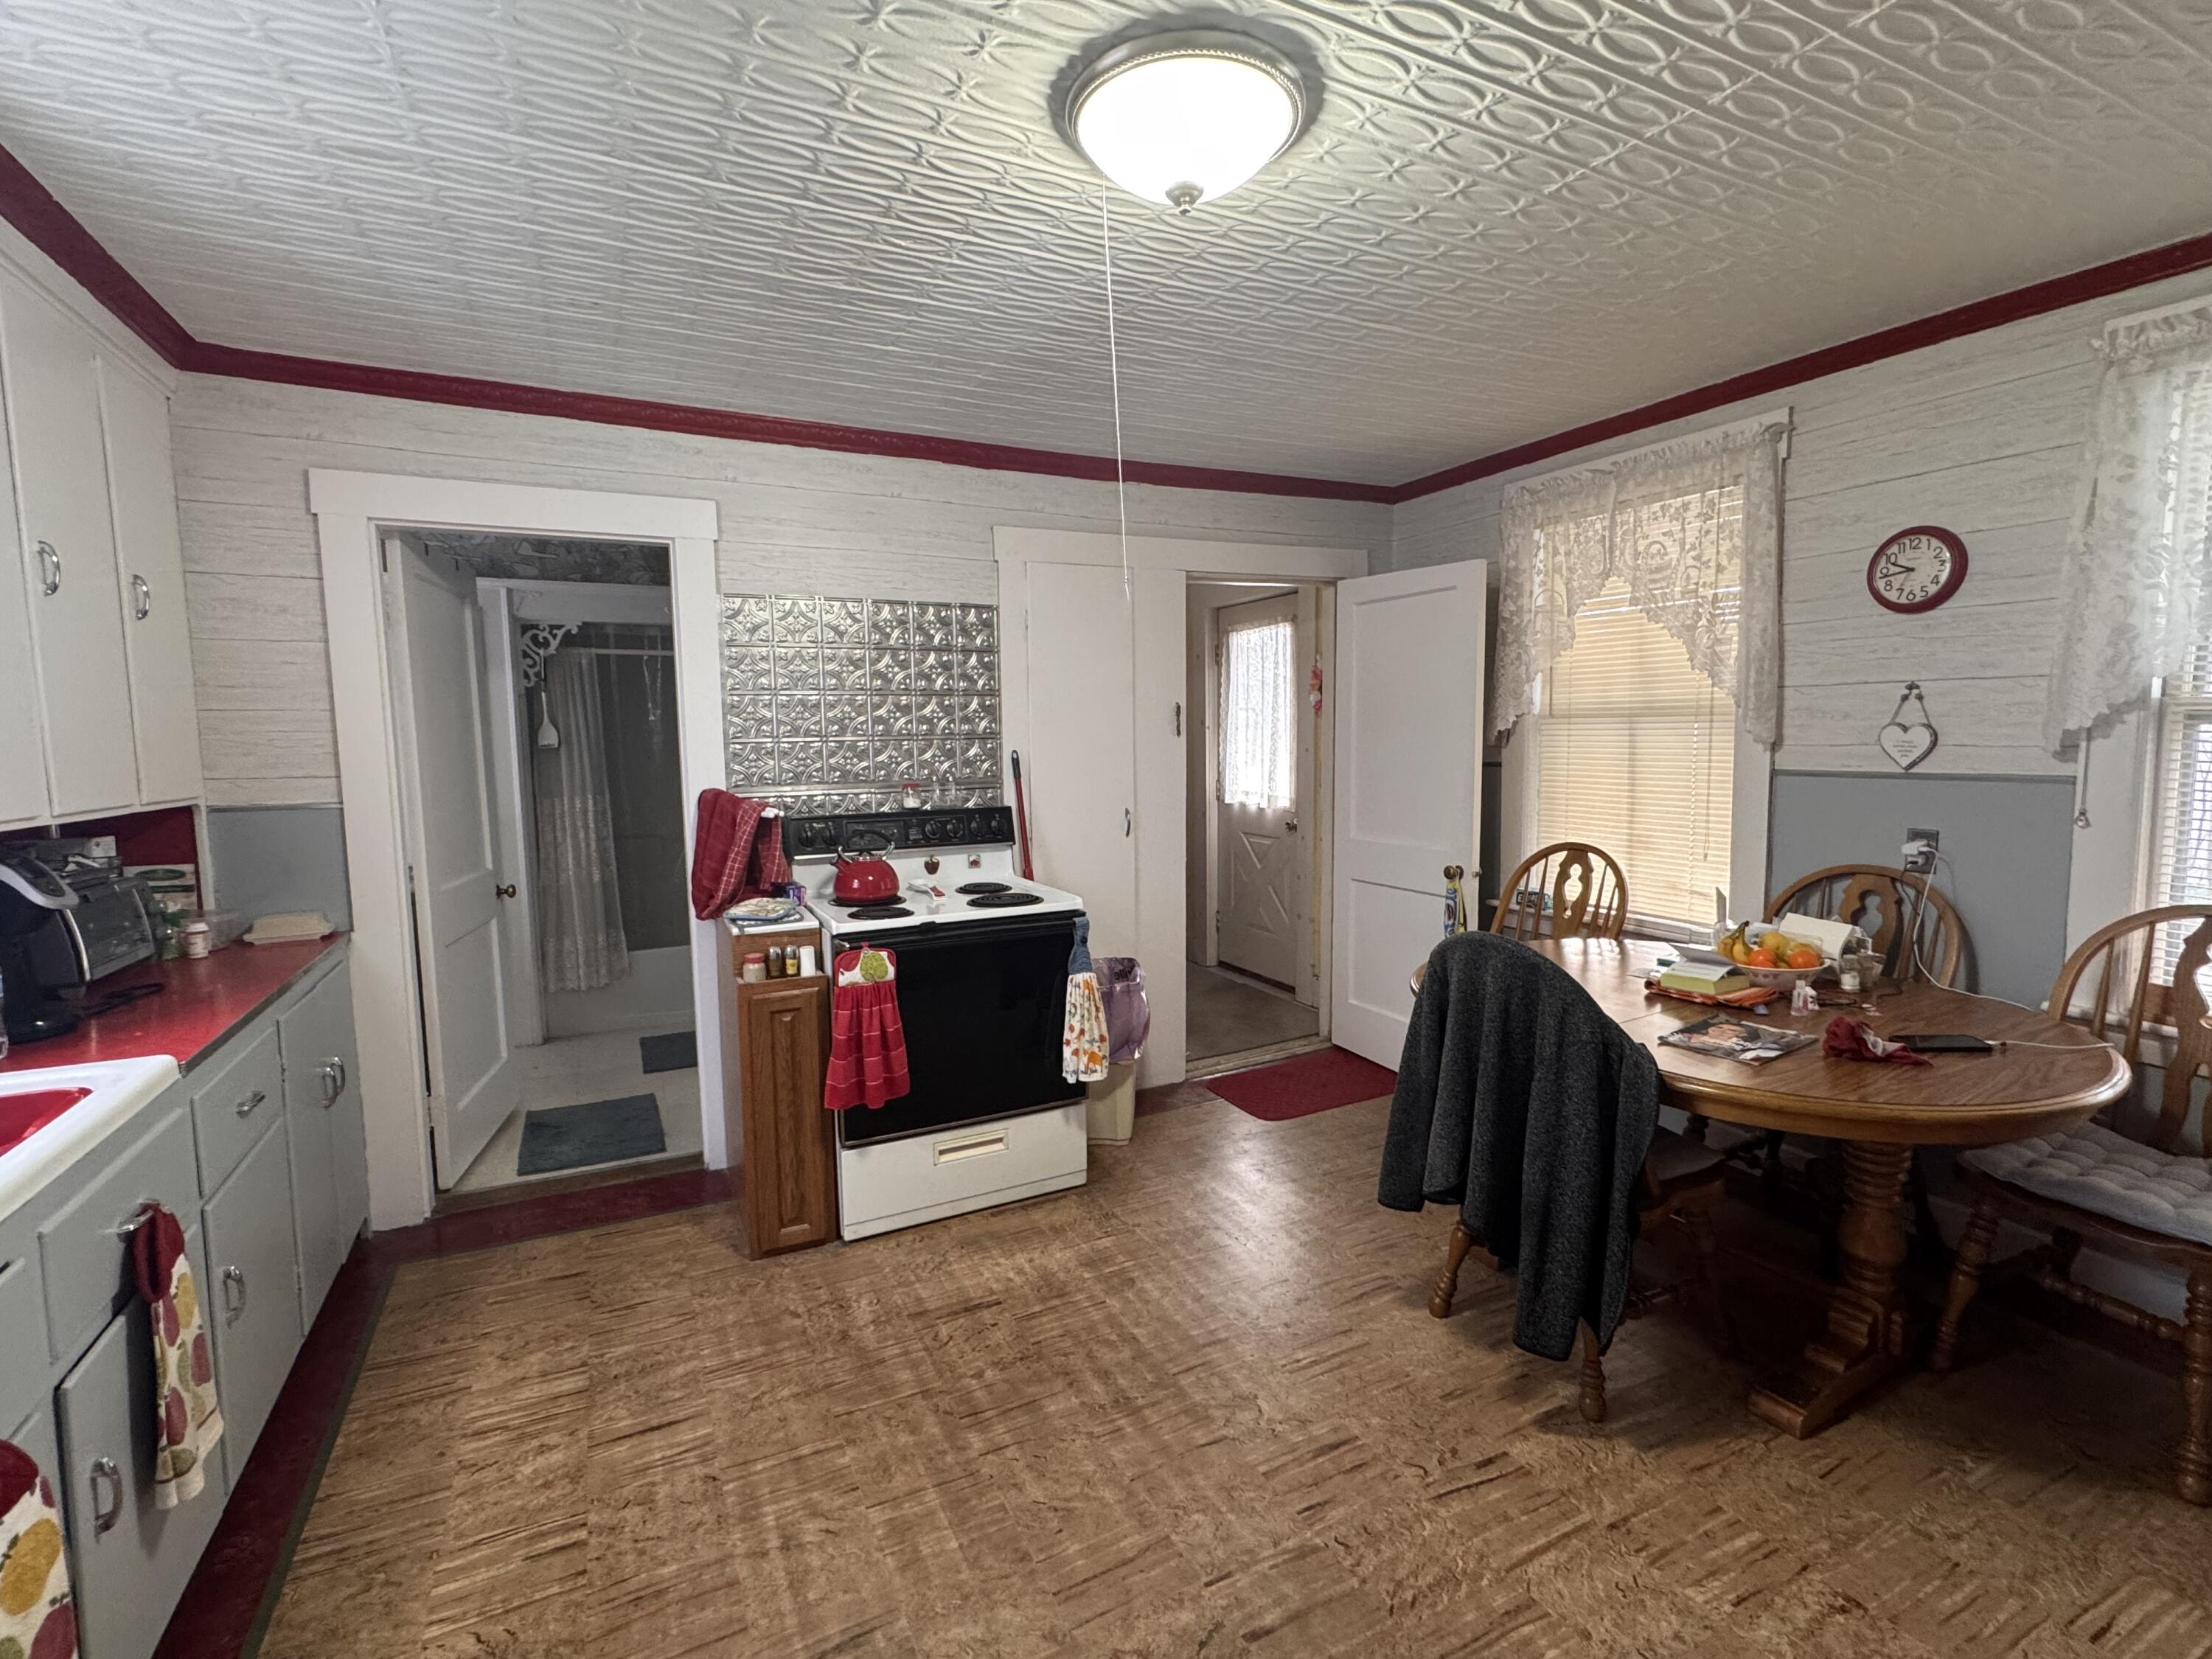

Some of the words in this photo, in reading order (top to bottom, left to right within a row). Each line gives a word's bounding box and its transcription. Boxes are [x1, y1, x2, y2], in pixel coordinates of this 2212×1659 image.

[1897, 542, 1905, 554] 11
[1908, 537, 1921, 550] 12
[1926, 538, 1931, 551] 1
[1933, 546, 1944, 559] 2
[1882, 552, 1898, 566] 10
[1879, 566, 1889, 577] 9
[1937, 560, 1947, 572] 3
[1884, 580, 1893, 591] 8
[1930, 574, 1941, 586] 4
[1896, 588, 1905, 600] 7
[1906, 589, 1916, 602] 6
[1919, 585, 1929, 598] 5
